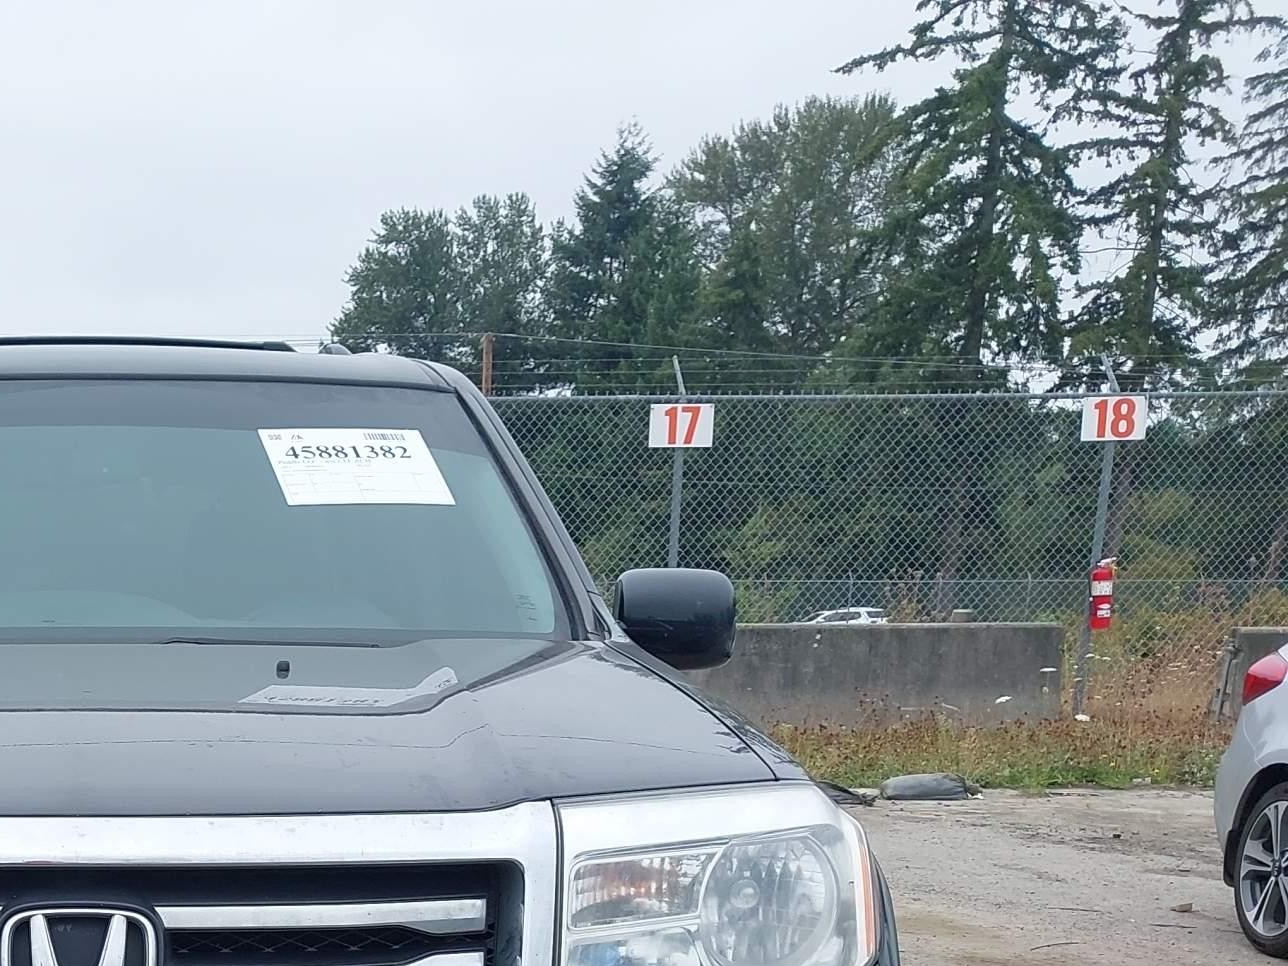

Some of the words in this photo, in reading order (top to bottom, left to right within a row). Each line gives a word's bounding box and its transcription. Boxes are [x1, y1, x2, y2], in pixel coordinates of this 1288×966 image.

[664, 406, 701, 444] 17
[1094, 398, 1135, 438] 18
[285, 445, 412, 459] 45881382
